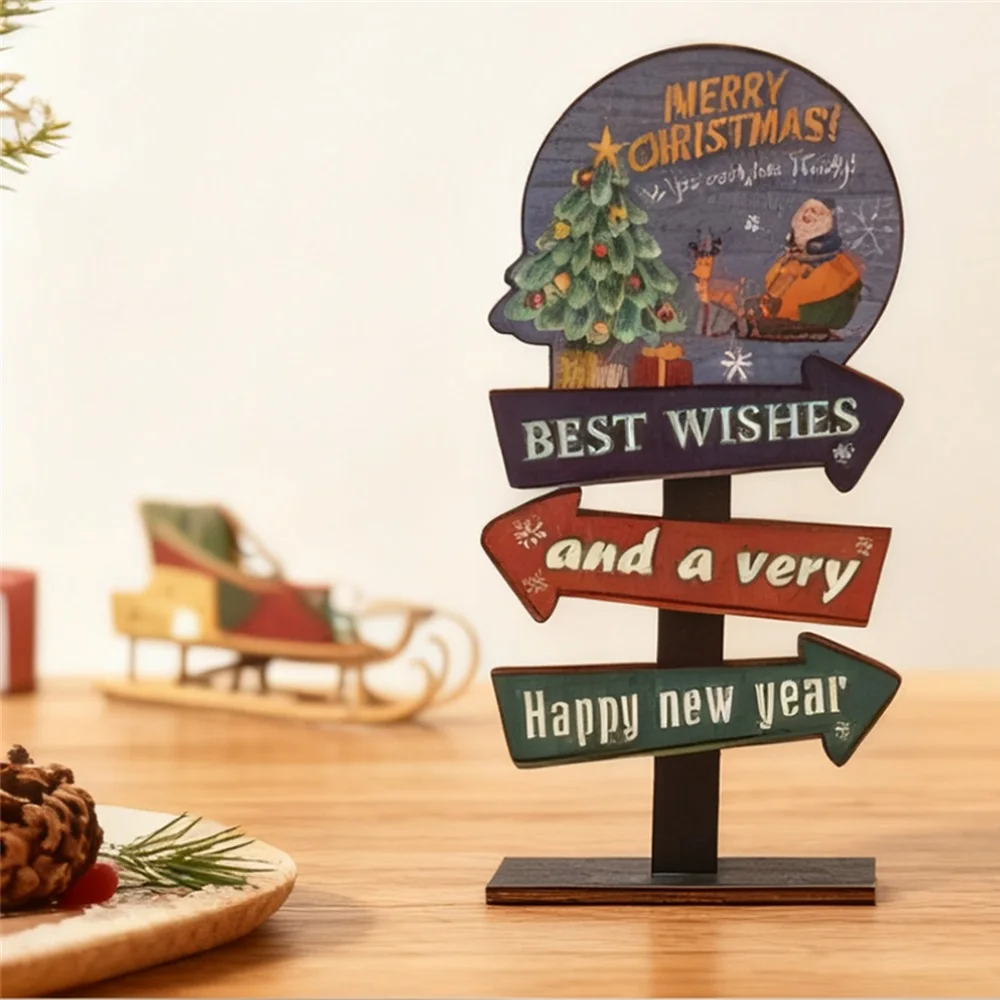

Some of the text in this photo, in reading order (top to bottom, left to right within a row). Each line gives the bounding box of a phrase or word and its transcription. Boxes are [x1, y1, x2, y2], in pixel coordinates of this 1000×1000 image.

[664, 69, 788, 123] MERRY
[522, 397, 860, 460] BEST WISHES
[545, 526, 860, 604] and a very
[523, 675, 847, 746] Happy new year
